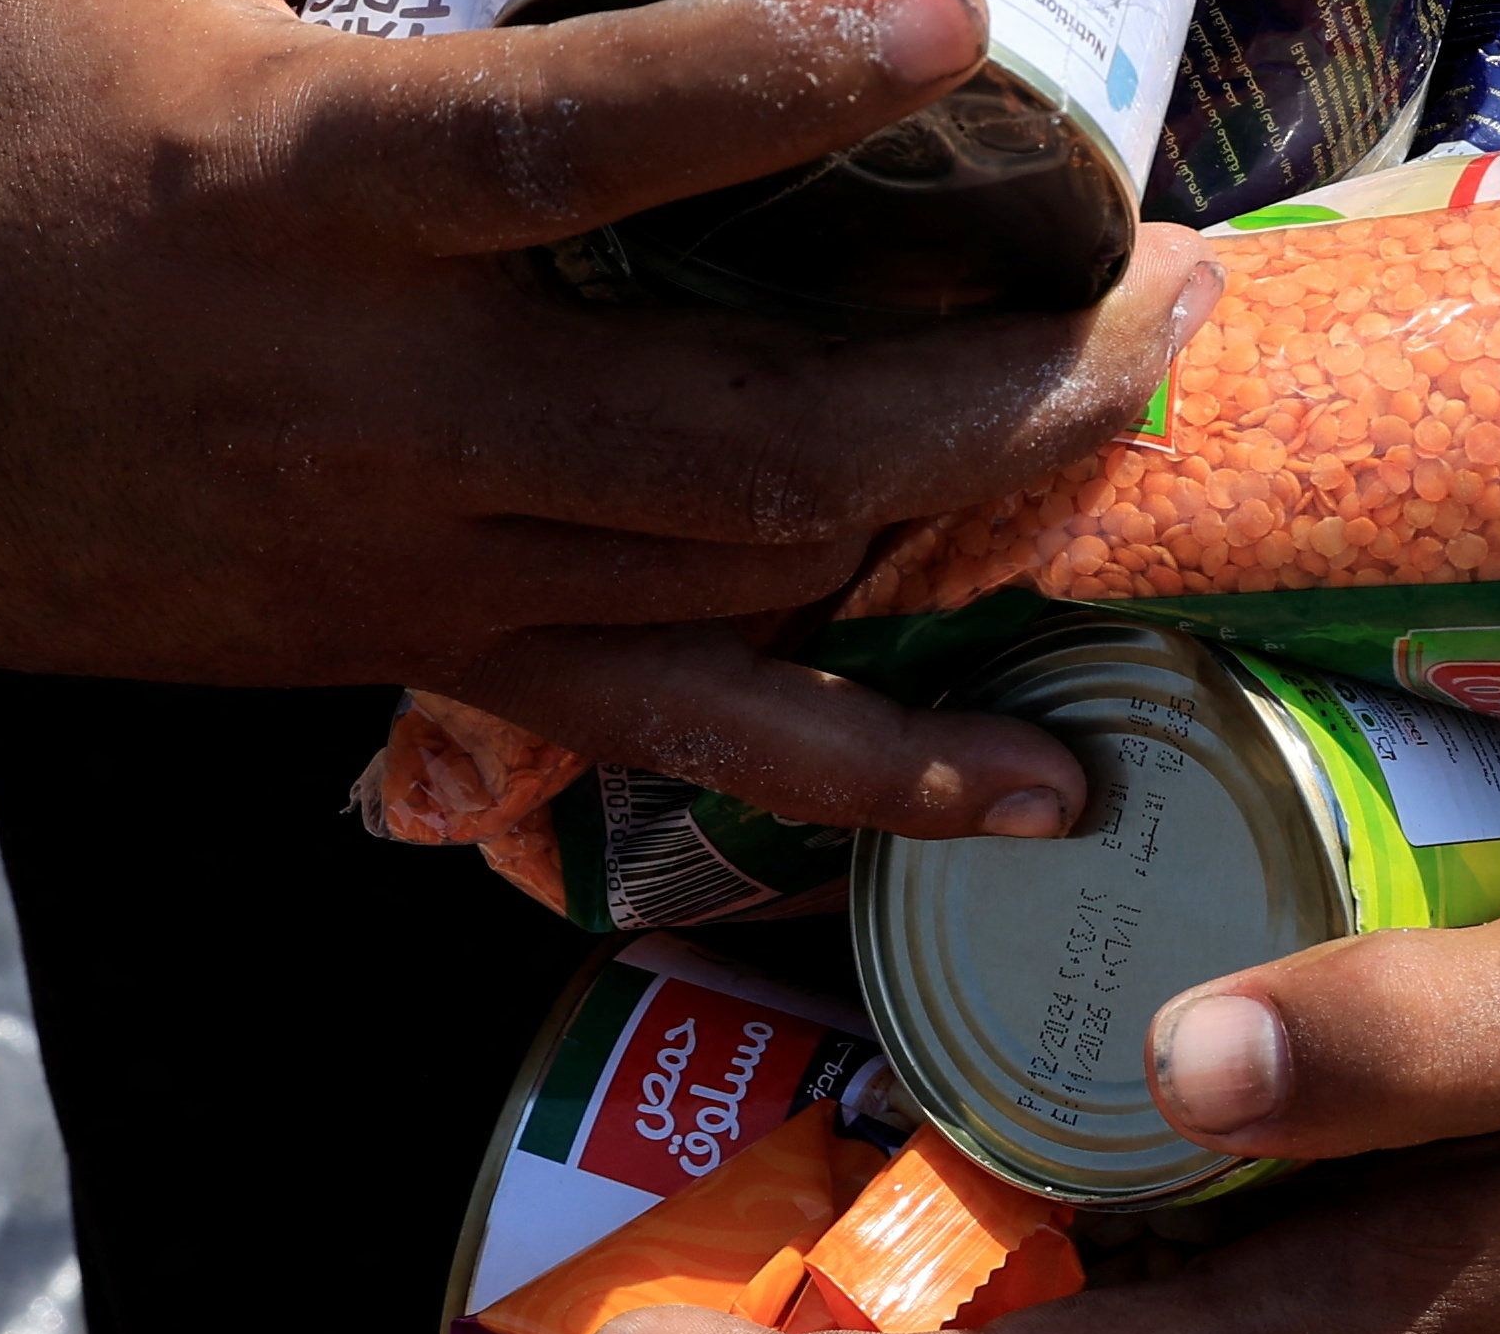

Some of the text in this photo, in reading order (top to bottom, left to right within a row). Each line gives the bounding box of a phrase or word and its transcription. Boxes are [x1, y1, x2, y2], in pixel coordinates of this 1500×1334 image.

[1288, 40, 1317, 81] (S.A.E)
[1304, 76, 1327, 108] pasta
[1315, 106, 1331, 124] for
[624, 1008, 712, 1146] حمص
[1025, 989, 1079, 1082] 12/2024
[1059, 1001, 1113, 1095] 11/2026
[661, 1005, 778, 1185] مسلوق
